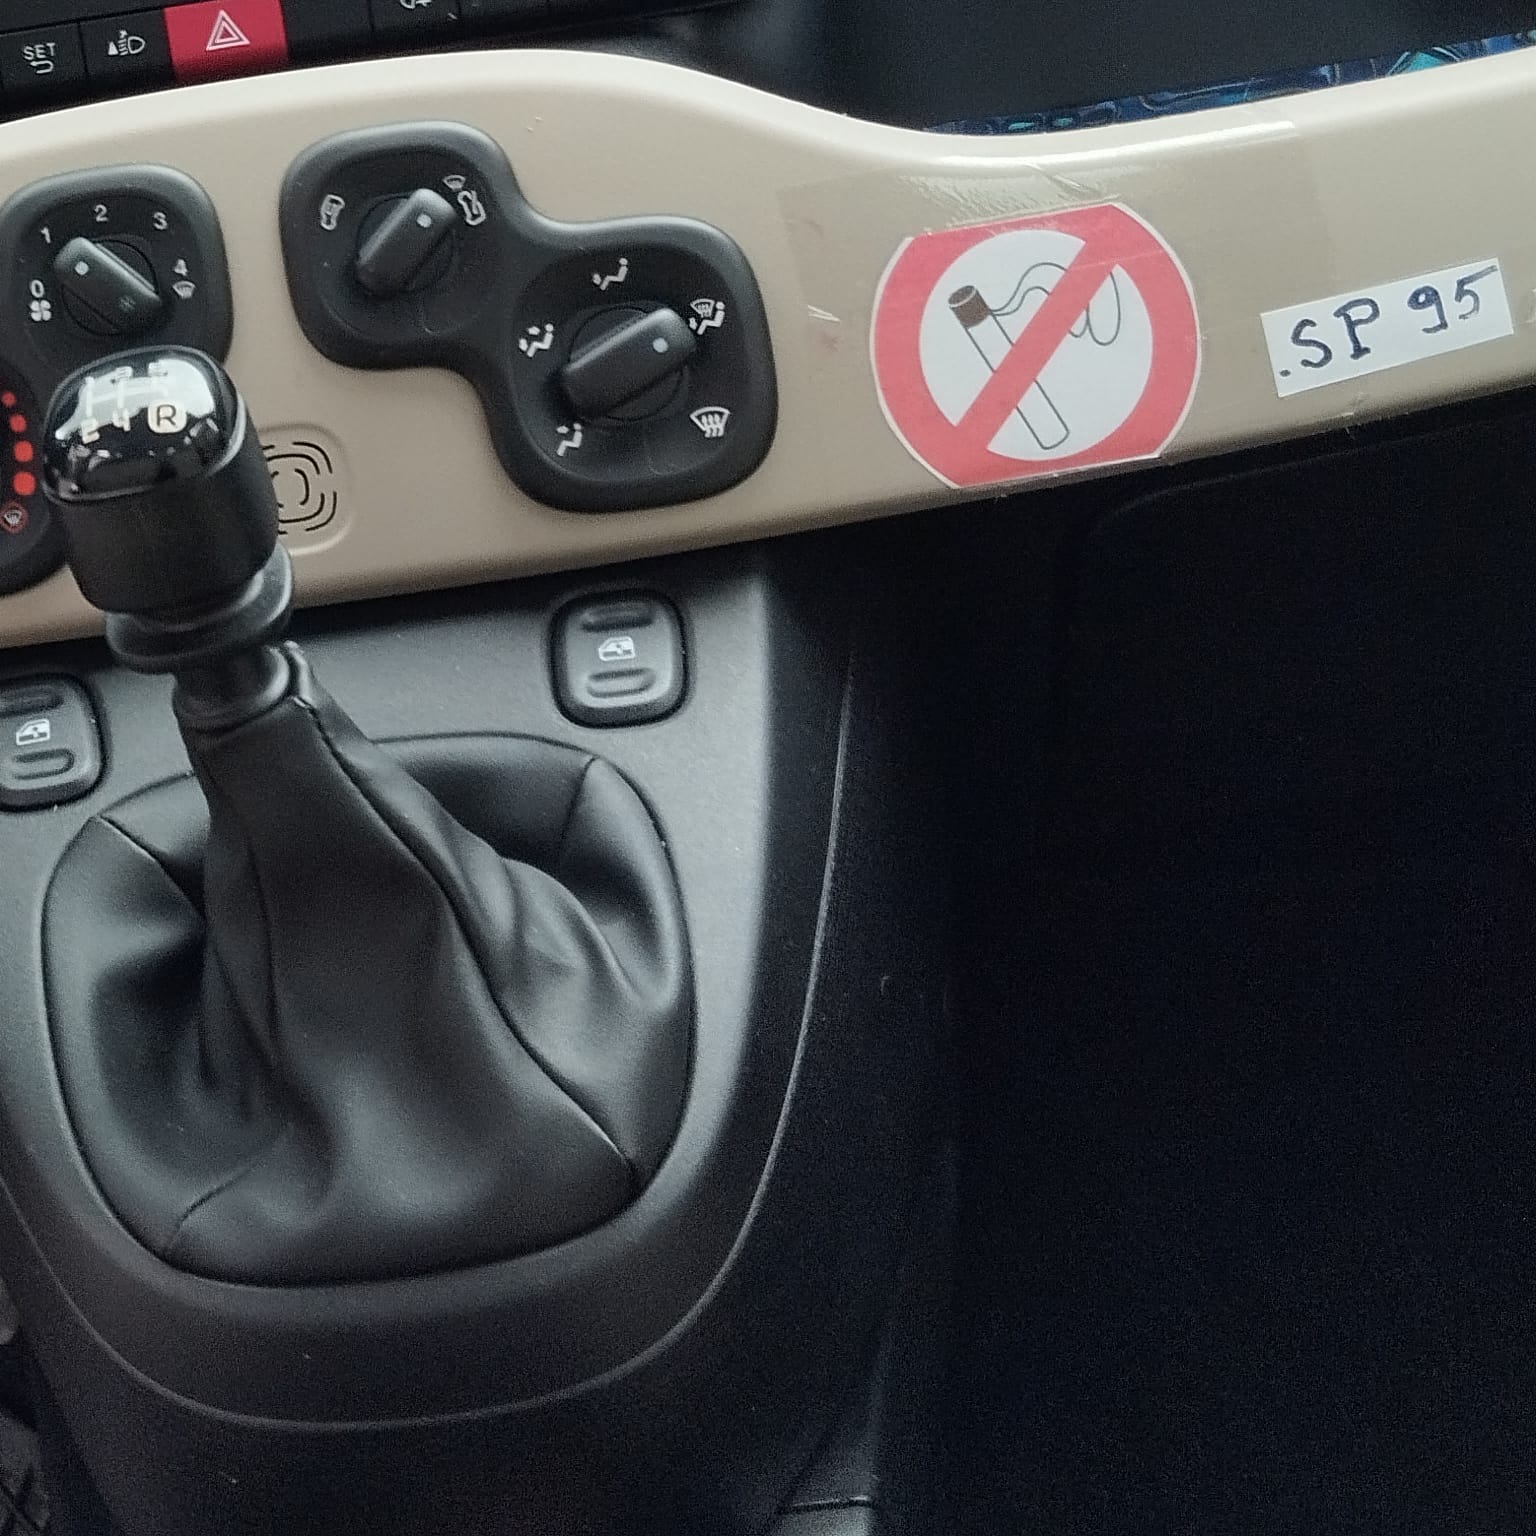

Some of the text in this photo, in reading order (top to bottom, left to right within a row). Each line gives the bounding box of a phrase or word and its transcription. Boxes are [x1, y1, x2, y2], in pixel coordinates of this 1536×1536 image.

[23, 42, 56, 61] SET
[94, 204, 109, 222] 2
[153, 212, 168, 231] 3
[40, 226, 52, 244] 1
[173, 258, 188, 277] 4
[30, 279, 45, 298] 0
[1407, 265, 1499, 333] 95
[156, 404, 178, 427] R
